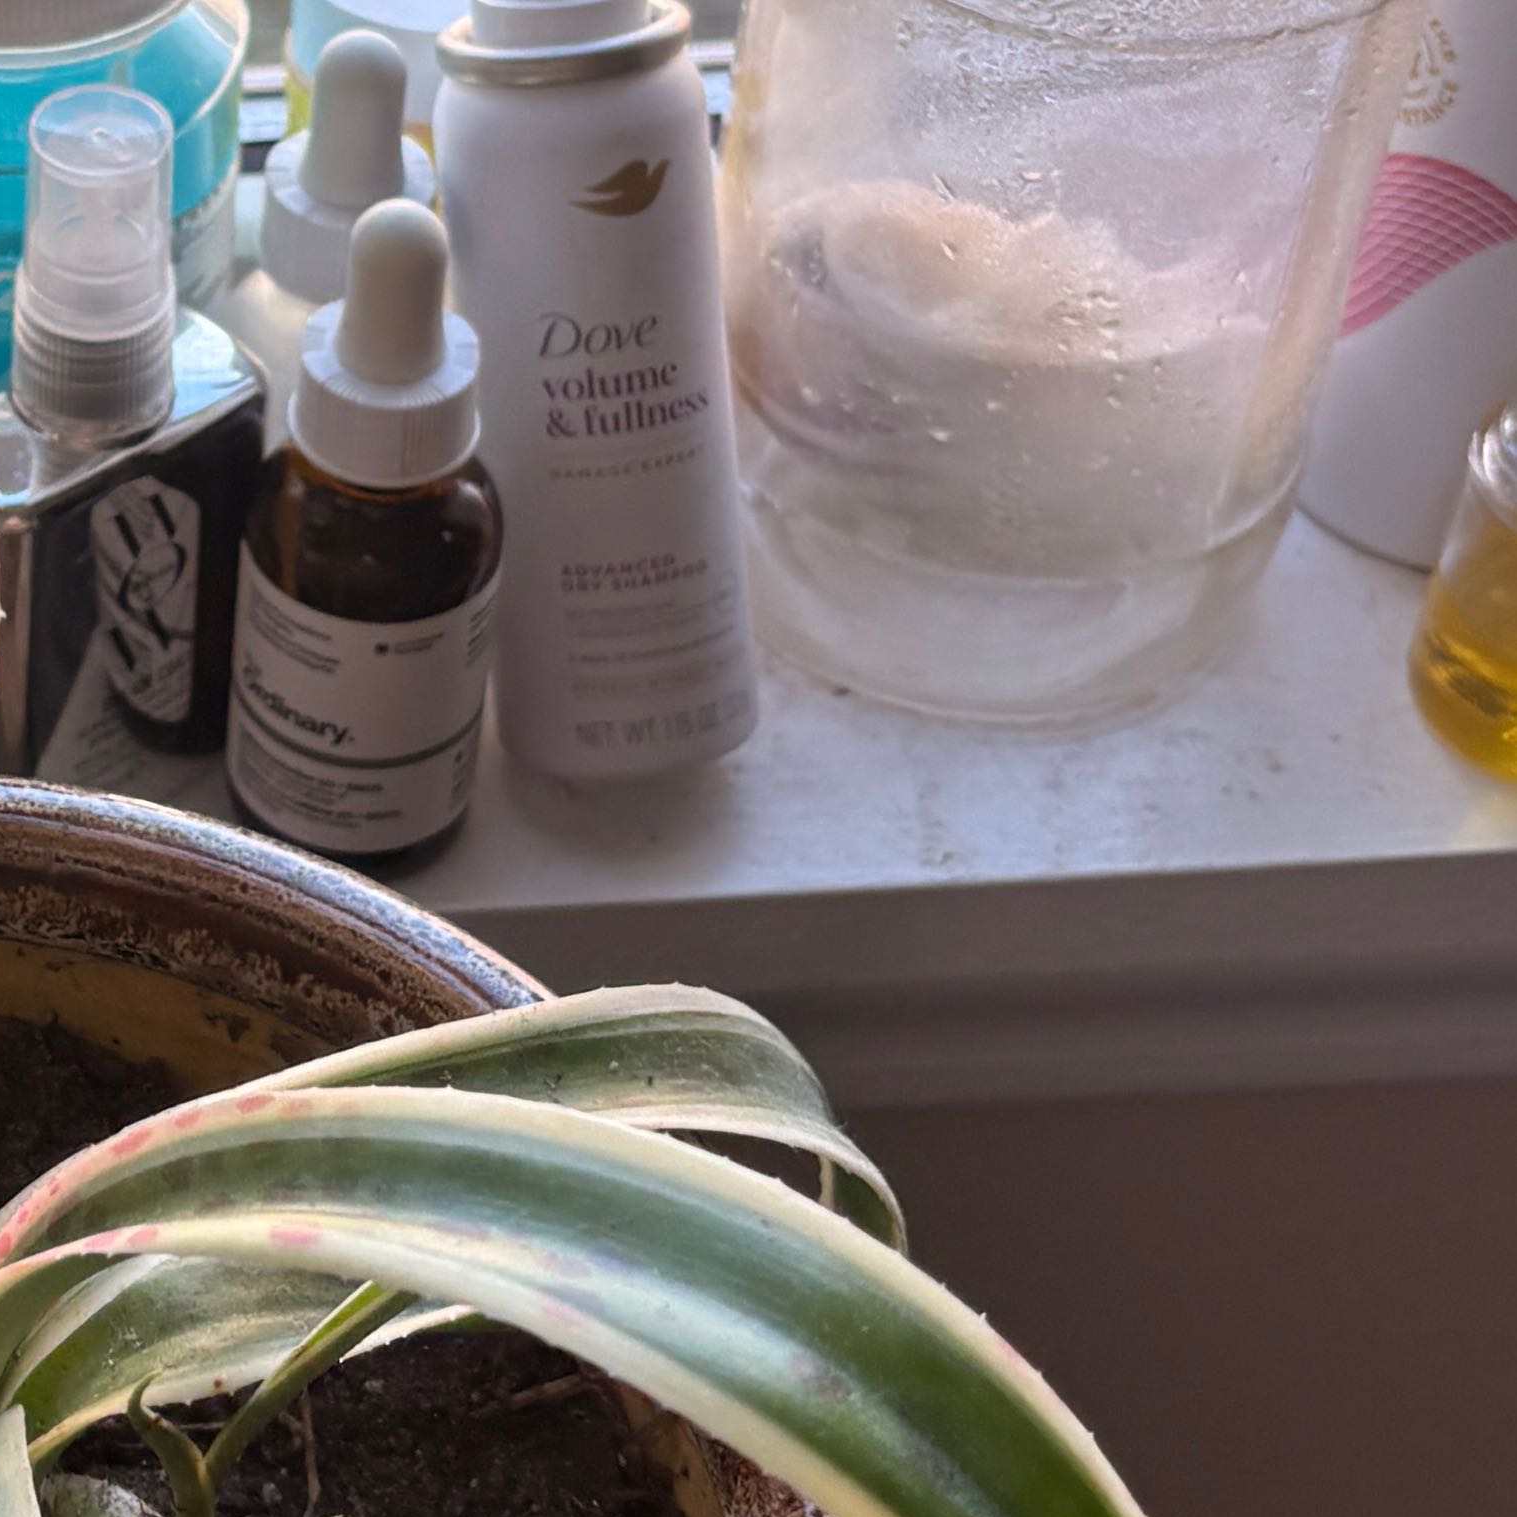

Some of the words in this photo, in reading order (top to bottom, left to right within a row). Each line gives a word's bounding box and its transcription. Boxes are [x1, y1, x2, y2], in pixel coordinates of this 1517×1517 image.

[539, 311, 658, 358] Dove
[542, 362, 678, 400] volume
[546, 409, 578, 439] &
[584, 388, 710, 436] fullness
